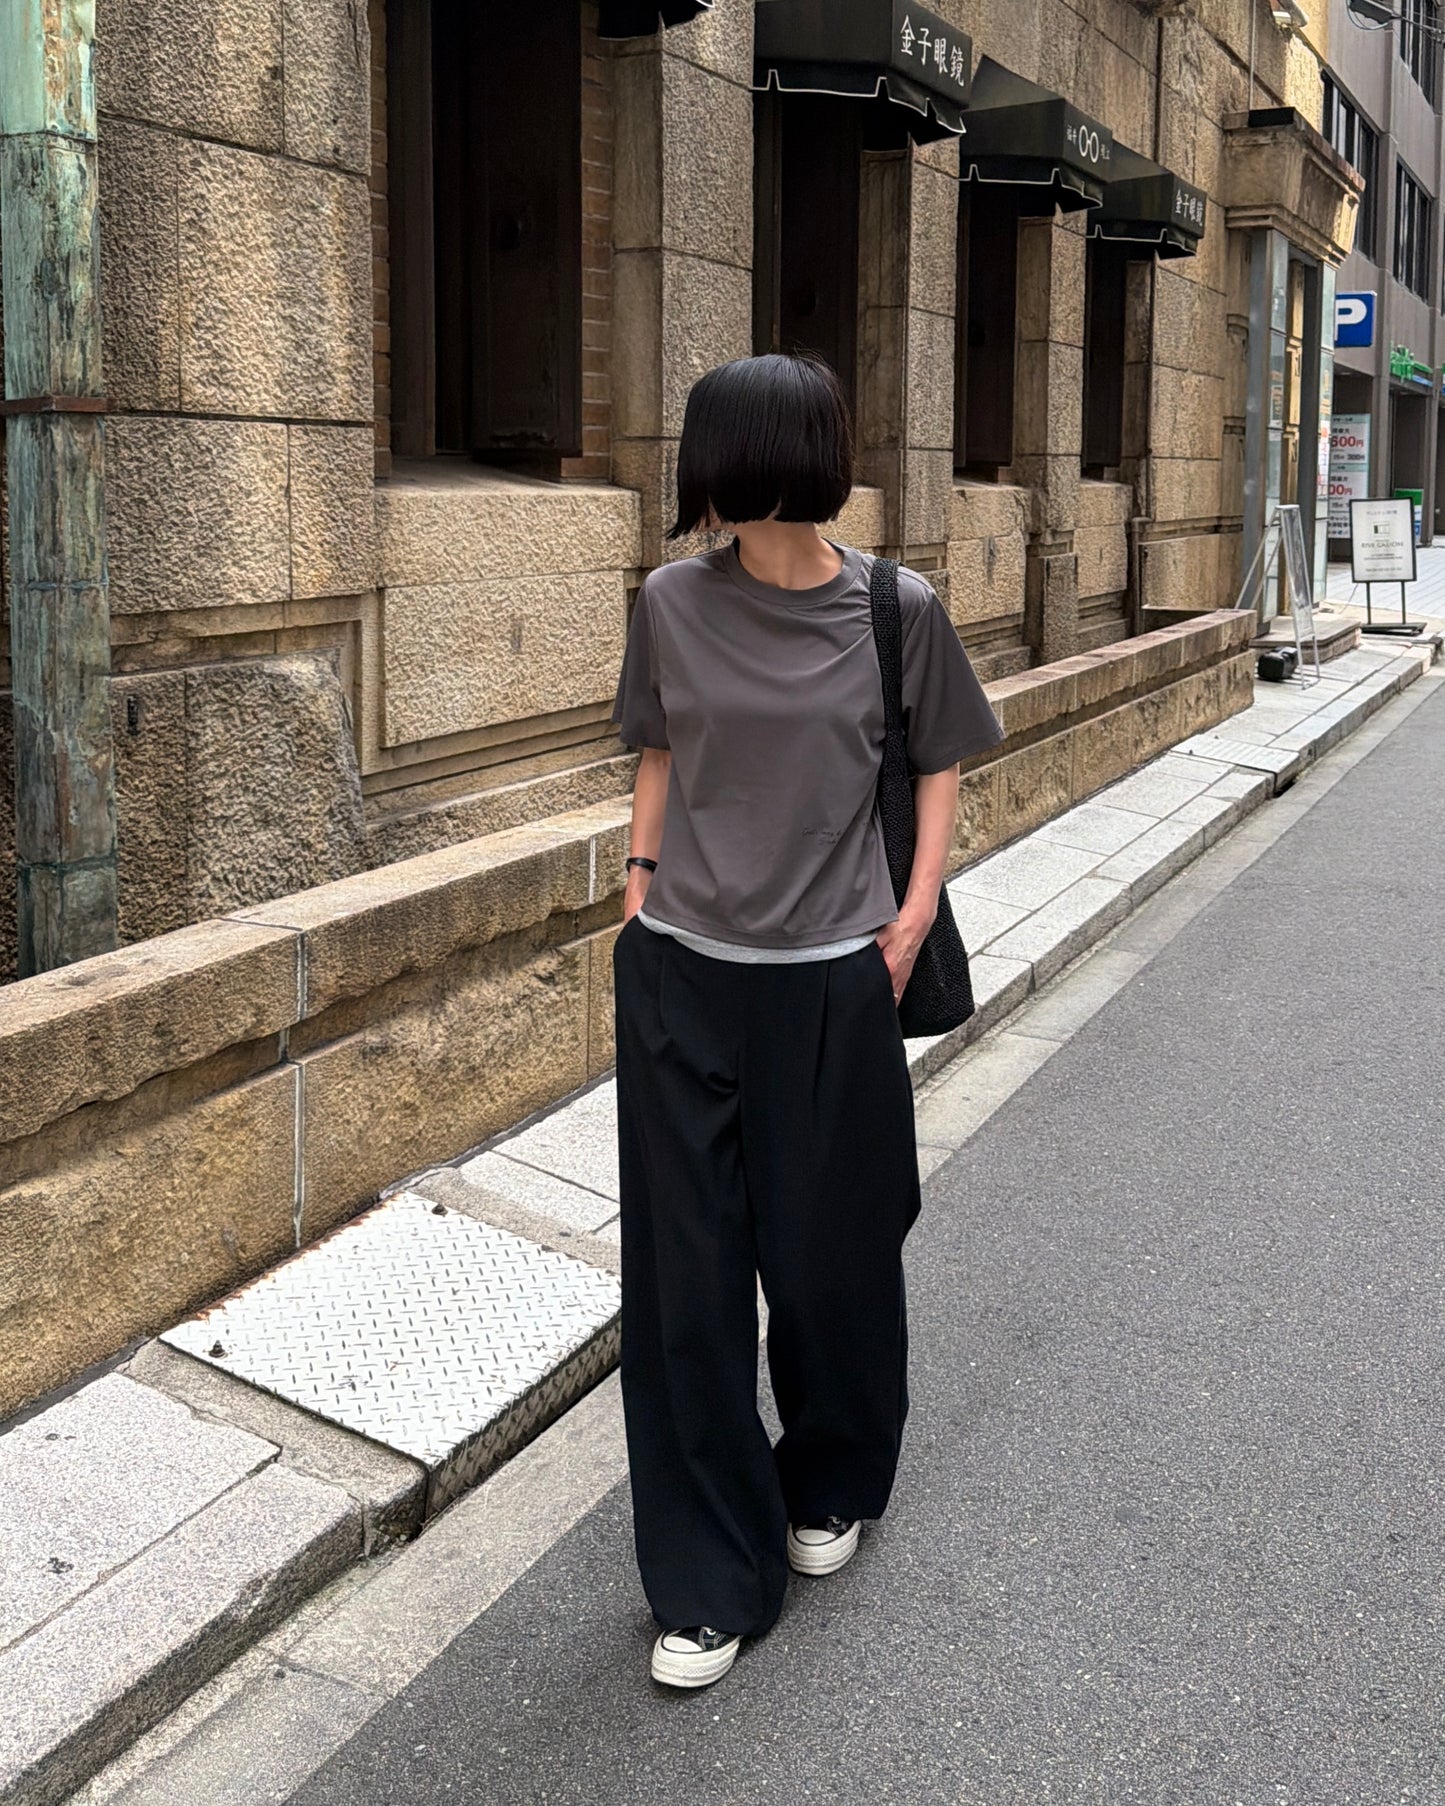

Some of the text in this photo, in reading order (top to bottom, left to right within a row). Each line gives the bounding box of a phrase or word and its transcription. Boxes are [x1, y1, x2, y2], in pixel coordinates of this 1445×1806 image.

[900, 14, 964, 87] 金子眼鏡
[1334, 298, 1368, 341] P
